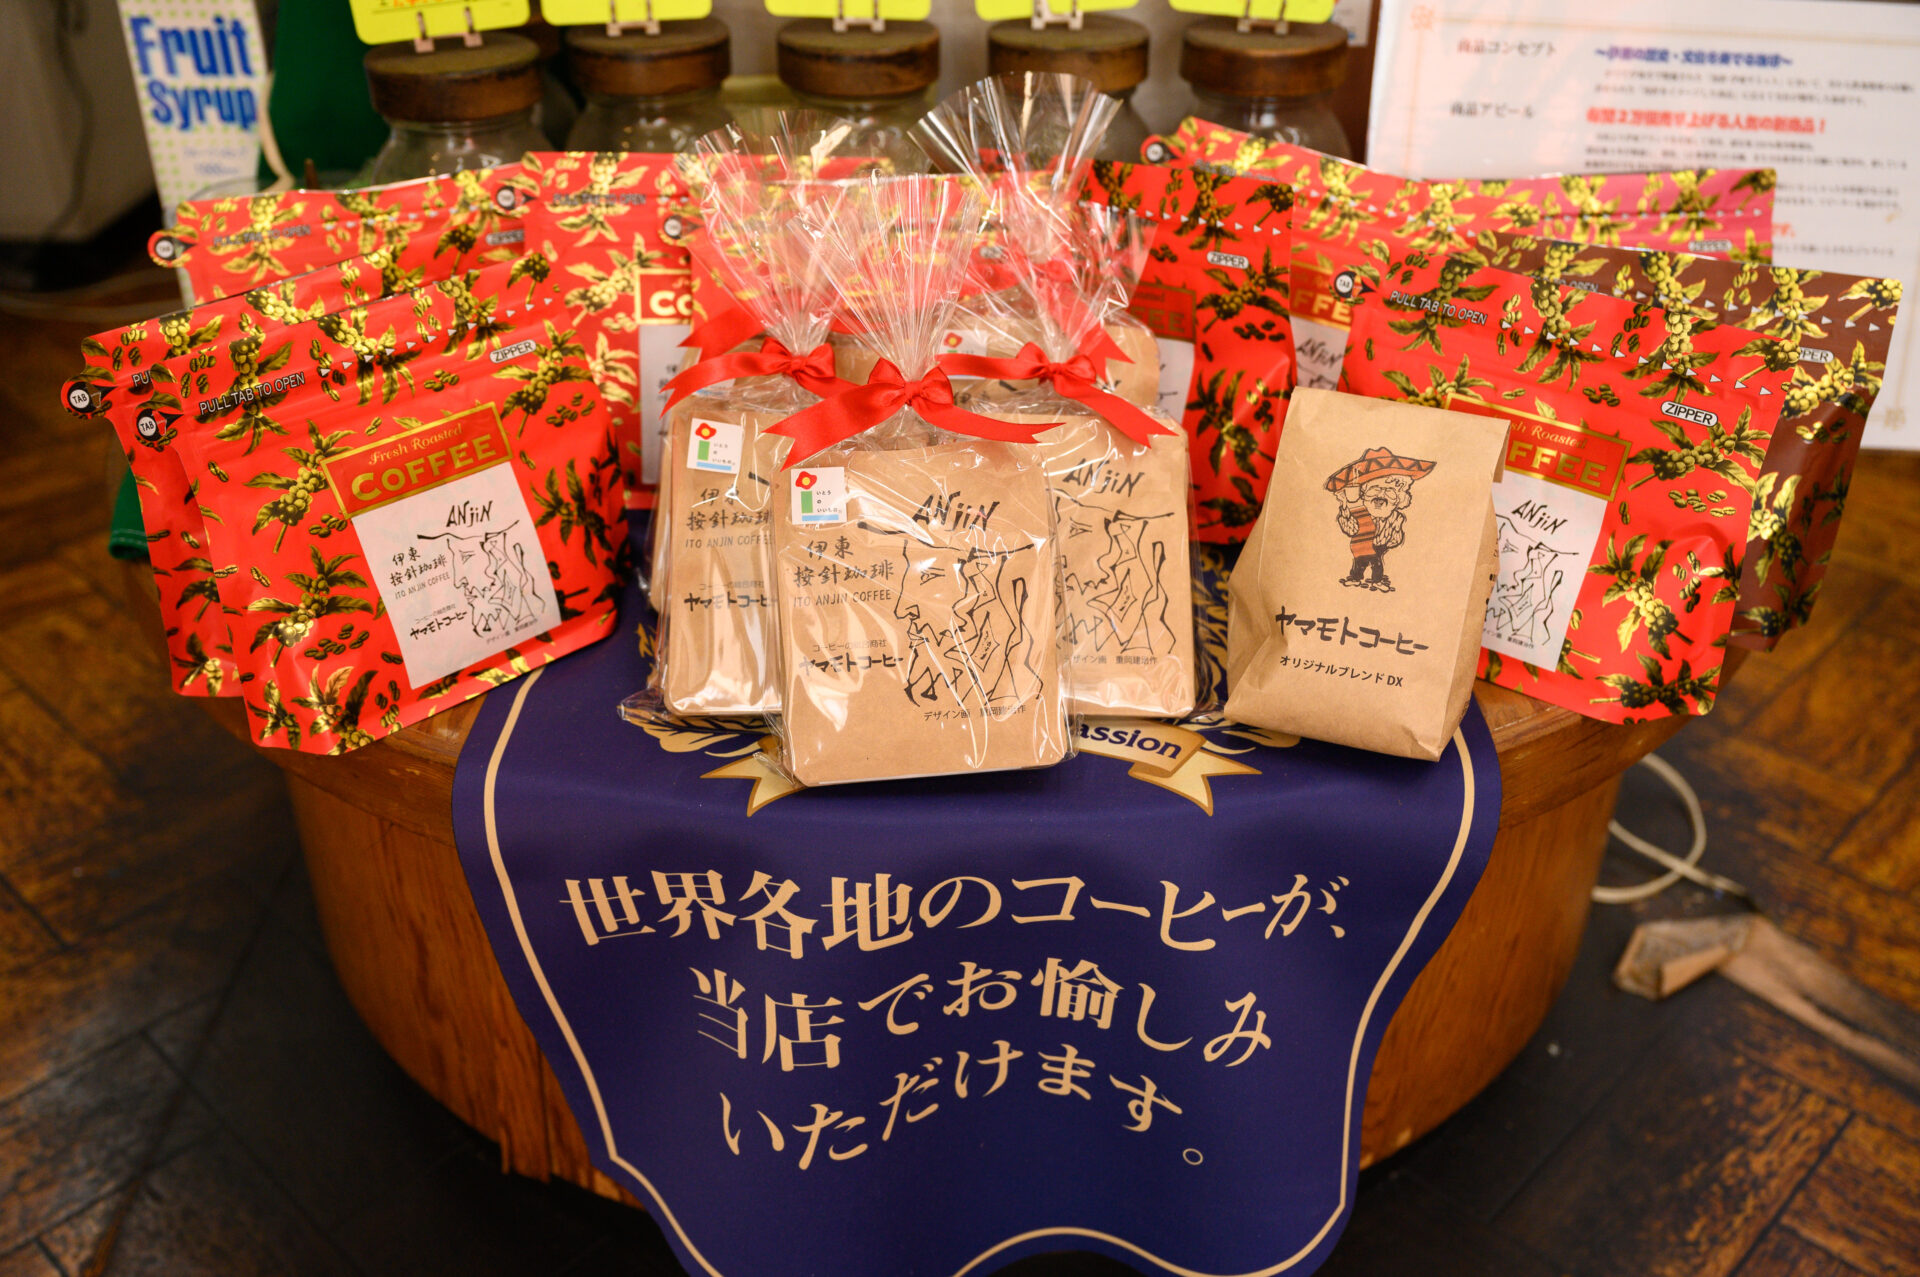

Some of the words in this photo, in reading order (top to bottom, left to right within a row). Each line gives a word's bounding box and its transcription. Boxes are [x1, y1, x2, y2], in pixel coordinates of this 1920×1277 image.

[130, 15, 253, 76] Fruit
[148, 79, 258, 131] Syrup
[1210, 252, 1246, 268] ZIPPER
[1390, 290, 1417, 309] PULL
[1420, 296, 1439, 313] TAB
[1441, 303, 1457, 317] TO
[1457, 307, 1488, 326] OPEN
[493, 341, 533, 363] ZIPPER
[71, 393, 88, 404] TAB
[199, 398, 232, 416] PULL
[230, 387, 254, 405] TAB
[256, 381, 273, 397] TO
[274, 372, 306, 392] OPEN
[140, 420, 155, 432] TAB
[1664, 402, 1713, 425] ZIPPER
[368, 444, 408, 466] Fresh
[410, 423, 463, 451] Roasted
[351, 433, 497, 501] COFFEE
[391, 546, 421, 567] 伊東
[685, 538, 703, 549] ITO
[707, 535, 734, 548] ANJIN
[806, 535, 854, 560] 伊東
[394, 589, 407, 600] ITO
[408, 581, 428, 596] ANJIN
[427, 571, 451, 587] COFFEE
[794, 559, 895, 589] 按針珈琲
[794, 595, 811, 608] ITO
[815, 592, 848, 607] ANJIN
[852, 589, 892, 603] COFFEE
[409, 610, 468, 641] ヤマモトコーヒー
[1274, 605, 1430, 656] ヤマモトコーヒー
[799, 652, 904, 677] ヤマモトコーヒー
[559, 867, 1350, 960] 世界各地のコーヒーが、
[689, 957, 1273, 1072] 当店でお愉しみ
[720, 1040, 1205, 1170] いただけます。
